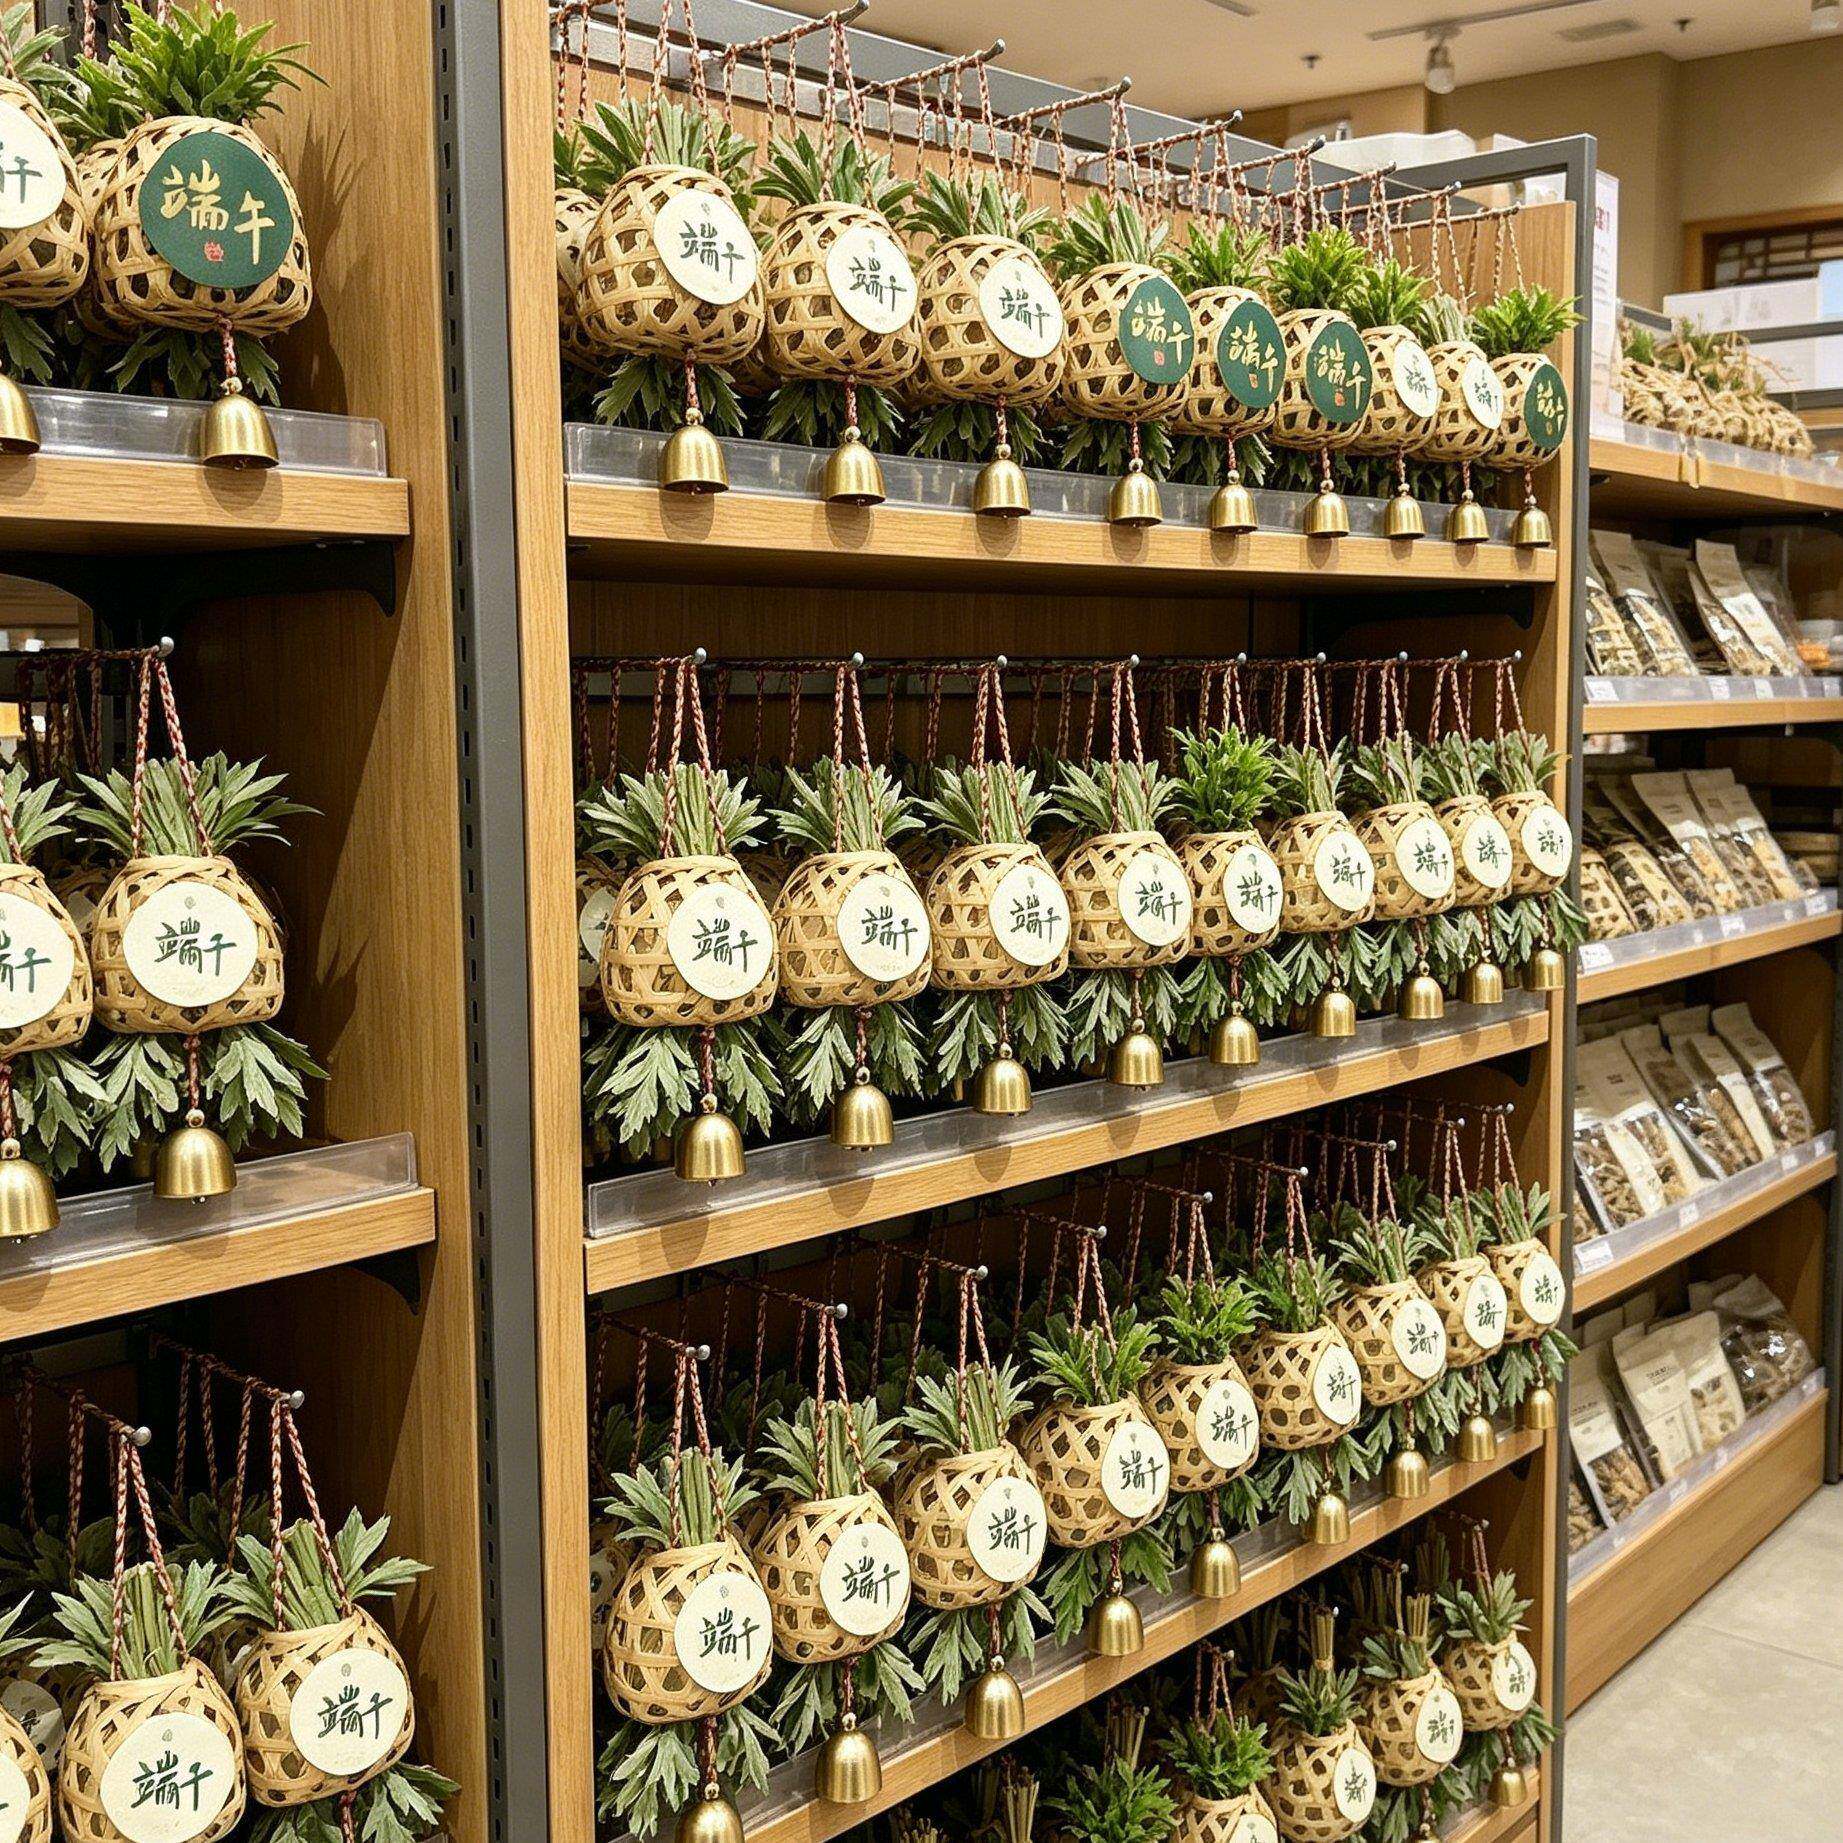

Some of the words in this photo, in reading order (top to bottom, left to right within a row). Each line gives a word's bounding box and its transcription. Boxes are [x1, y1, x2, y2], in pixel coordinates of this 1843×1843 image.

[0, 142, 42, 203] 午
[160, 159, 275, 265] 端午
[680, 219, 745, 284] 端午
[849, 255, 908, 311] 端午
[998, 286, 1051, 338] 端午
[1131, 296, 1191, 365] 端午
[1228, 320, 1279, 393] 端午
[1314, 338, 1367, 410] 端午
[155, 916, 237, 977] 端午
[692, 917, 758, 973] 端午
[861, 905, 919, 956] 端午
[1010, 894, 1062, 943] 端午
[988, 1506, 1038, 1555] 端午
[842, 1556, 901, 1606] 端午
[699, 1606, 760, 1662] 端午
[317, 1684, 394, 1740] 端午
[131, 1750, 213, 1812] 端午
